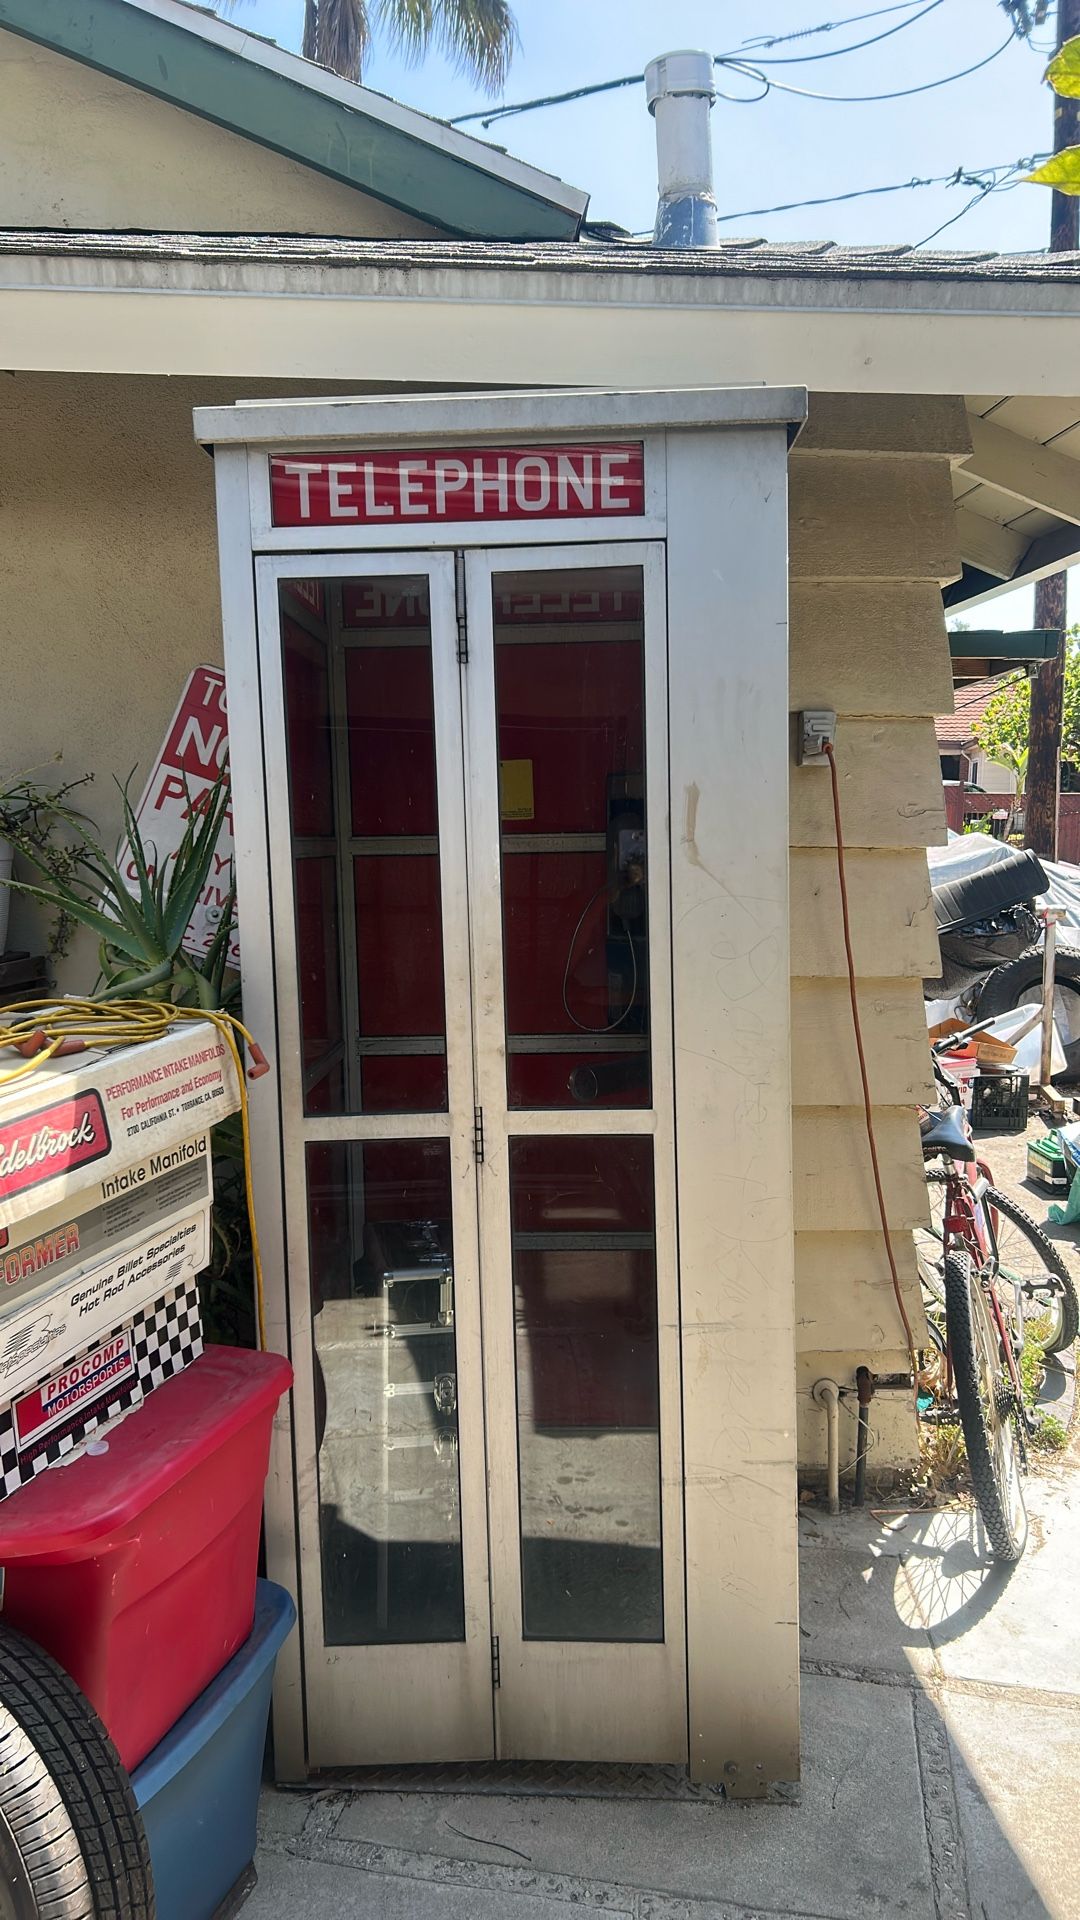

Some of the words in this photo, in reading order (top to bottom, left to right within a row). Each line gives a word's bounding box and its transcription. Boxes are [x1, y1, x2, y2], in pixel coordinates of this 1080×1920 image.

[285, 453, 630, 518] TELEPHONE
[105, 1068, 163, 1101] PERFORMANCE
[163, 1058, 189, 1078] INTAKE
[188, 1043, 225, 1068] MANIFOLDS
[121, 1106, 134, 1120] For
[136, 1087, 183, 1115] Performance
[182, 1080, 193, 1095] and
[194, 1070, 222, 1088] Economy
[141, 1112, 169, 1131] CALIFORNIA
[101, 1167, 146, 1199] Intake
[150, 1136, 207, 1176] Manifold
[70, 1274, 114, 1307] Genuine
[117, 1255, 143, 1279] Billet
[146, 1224, 197, 1260] Specialties
[79, 1297, 100, 1317] Hot
[103, 1279, 125, 1302] Rod
[127, 1244, 186, 1287] Accessories
[47, 1338, 124, 1401] PROCOMP
[47, 1357, 126, 1417] MOTORSPORTS
[20, 1447, 37, 1465] High
[40, 1418, 84, 1449] Performance
[84, 1402, 104, 1420] Intake
[105, 1380, 137, 1405] Manifolds
